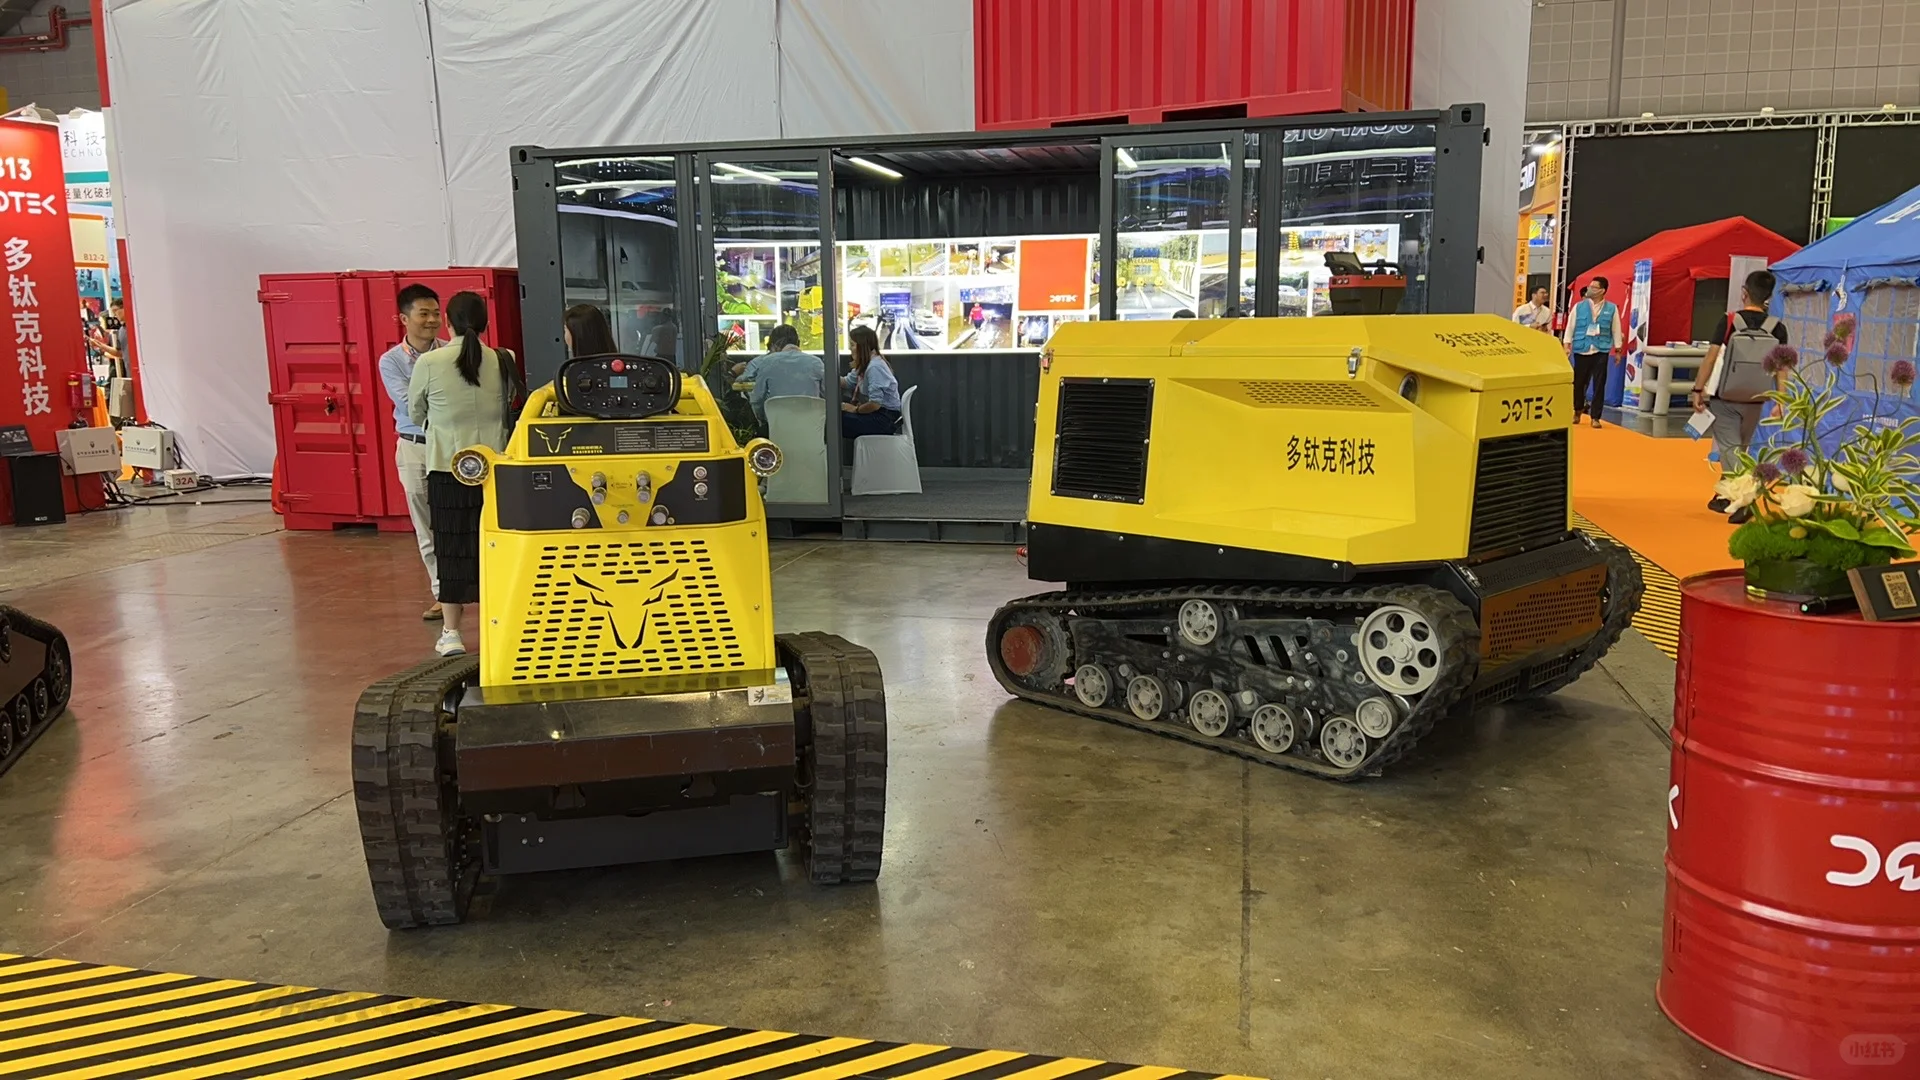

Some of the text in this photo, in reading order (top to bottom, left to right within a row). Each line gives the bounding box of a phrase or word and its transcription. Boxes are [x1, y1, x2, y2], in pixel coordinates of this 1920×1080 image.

[3, 236, 51, 416] 多钛克科技
[1434, 330, 1515, 348] 多钛克科技
[1501, 396, 1553, 423] DOTEK
[1286, 434, 1376, 475] 多钛克科技
[175, 477, 194, 486] 32A
